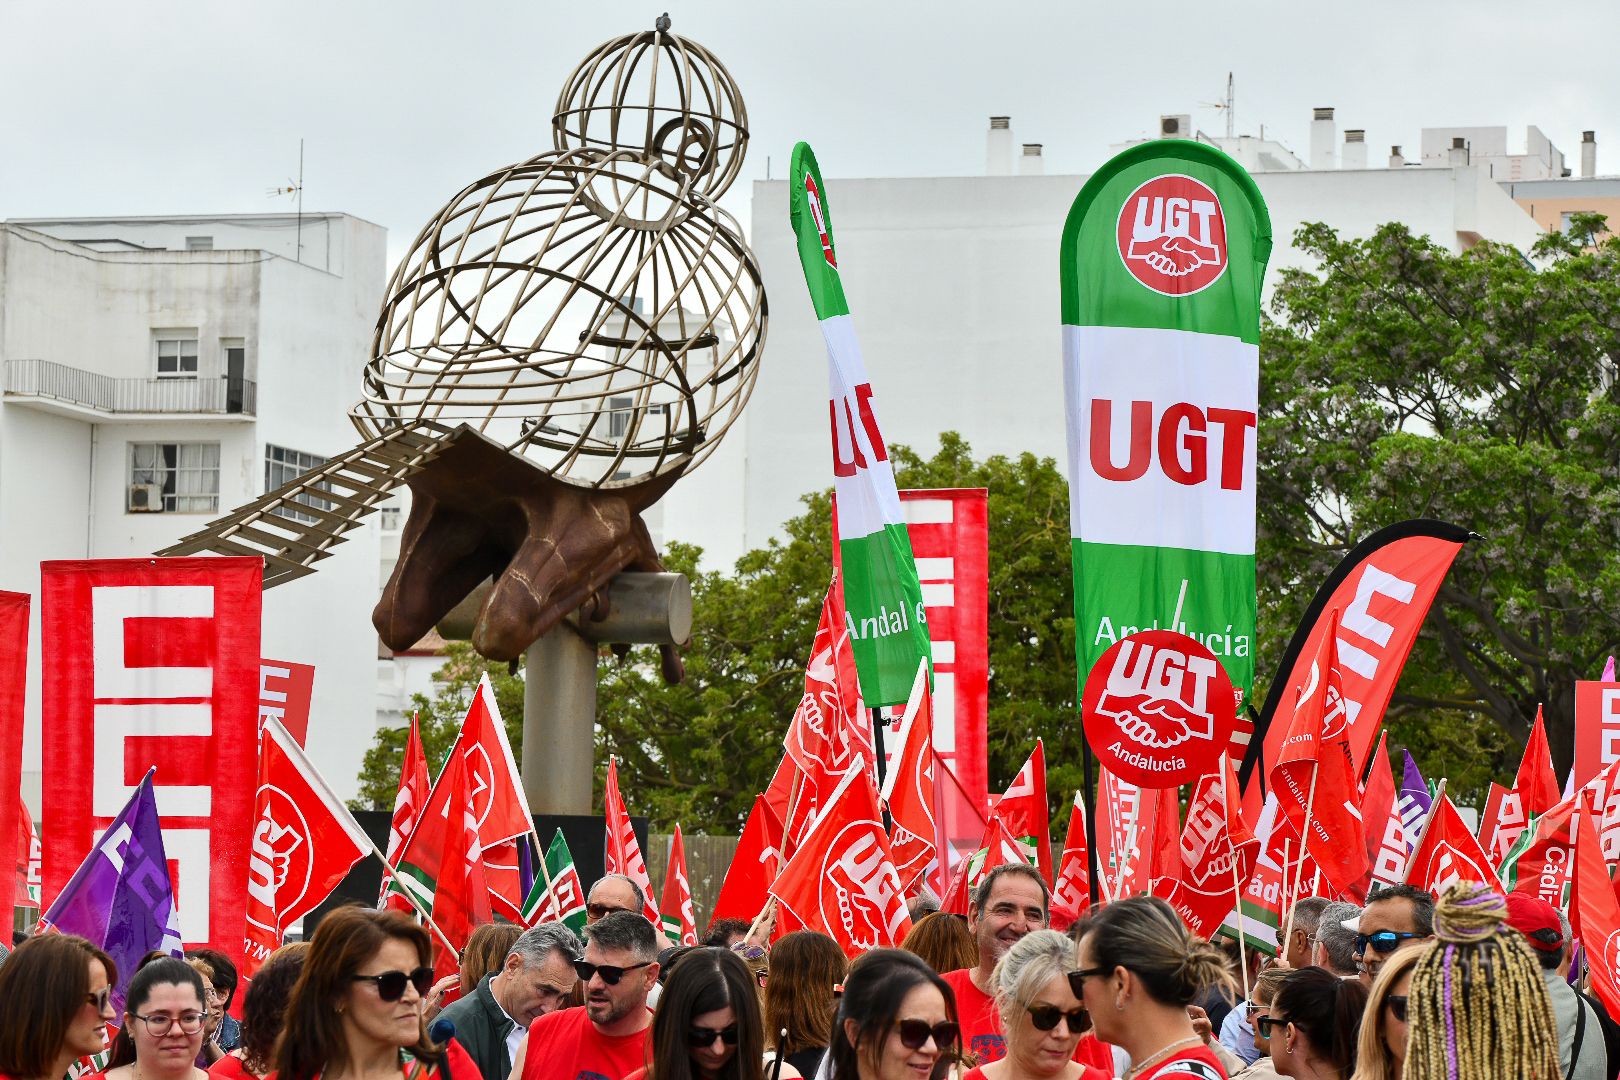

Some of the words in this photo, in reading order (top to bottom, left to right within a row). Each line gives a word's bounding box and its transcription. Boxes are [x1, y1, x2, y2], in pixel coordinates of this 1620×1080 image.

[1132, 196, 1216, 245] UGT
[1089, 398, 1256, 490] UGT
[1106, 640, 1217, 715] UGT
[1107, 741, 1186, 772] Andalucía
